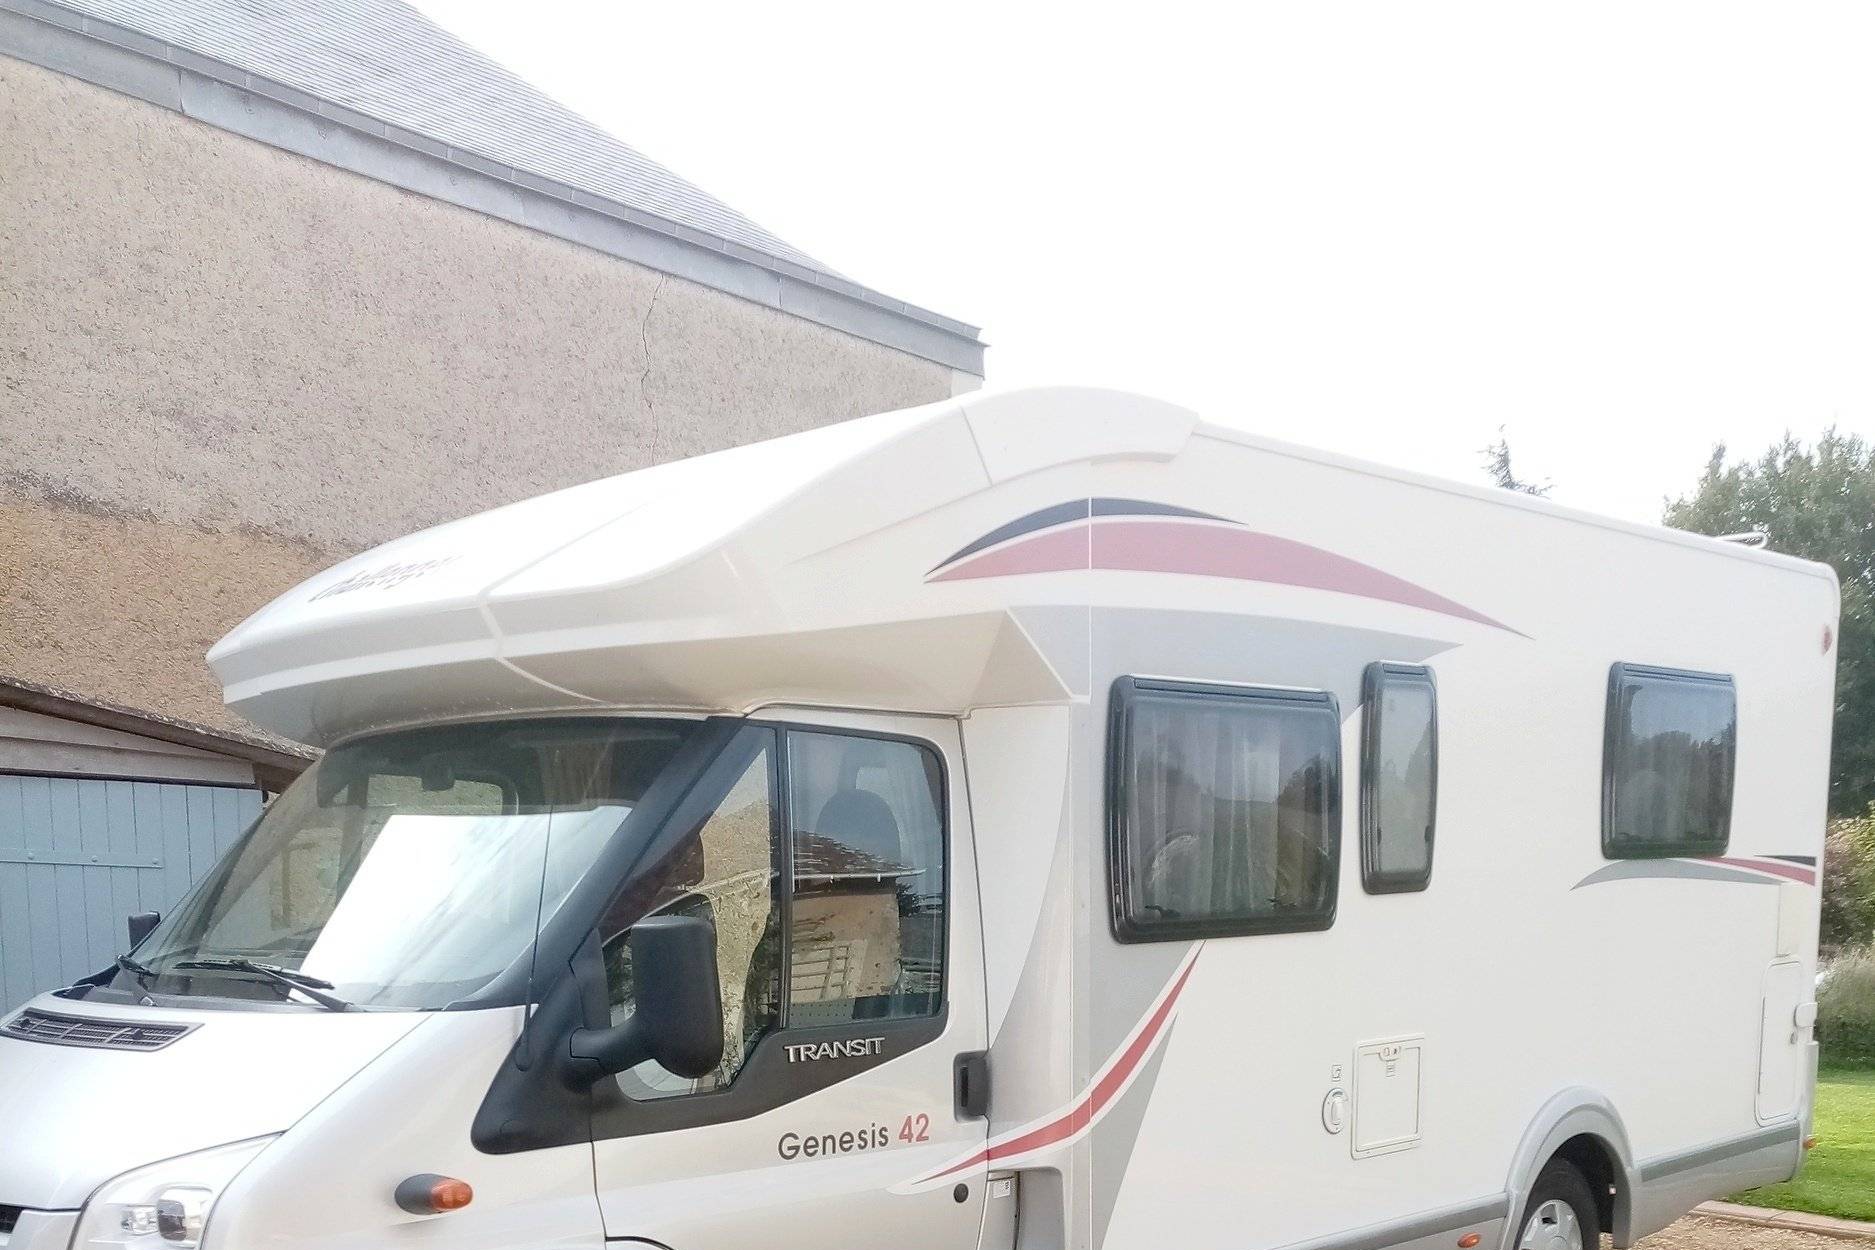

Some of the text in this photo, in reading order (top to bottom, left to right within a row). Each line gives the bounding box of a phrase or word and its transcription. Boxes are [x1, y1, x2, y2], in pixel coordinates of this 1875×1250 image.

[784, 1037, 886, 1063] TRANSIT
[778, 1113, 930, 1160] Genesis 42
